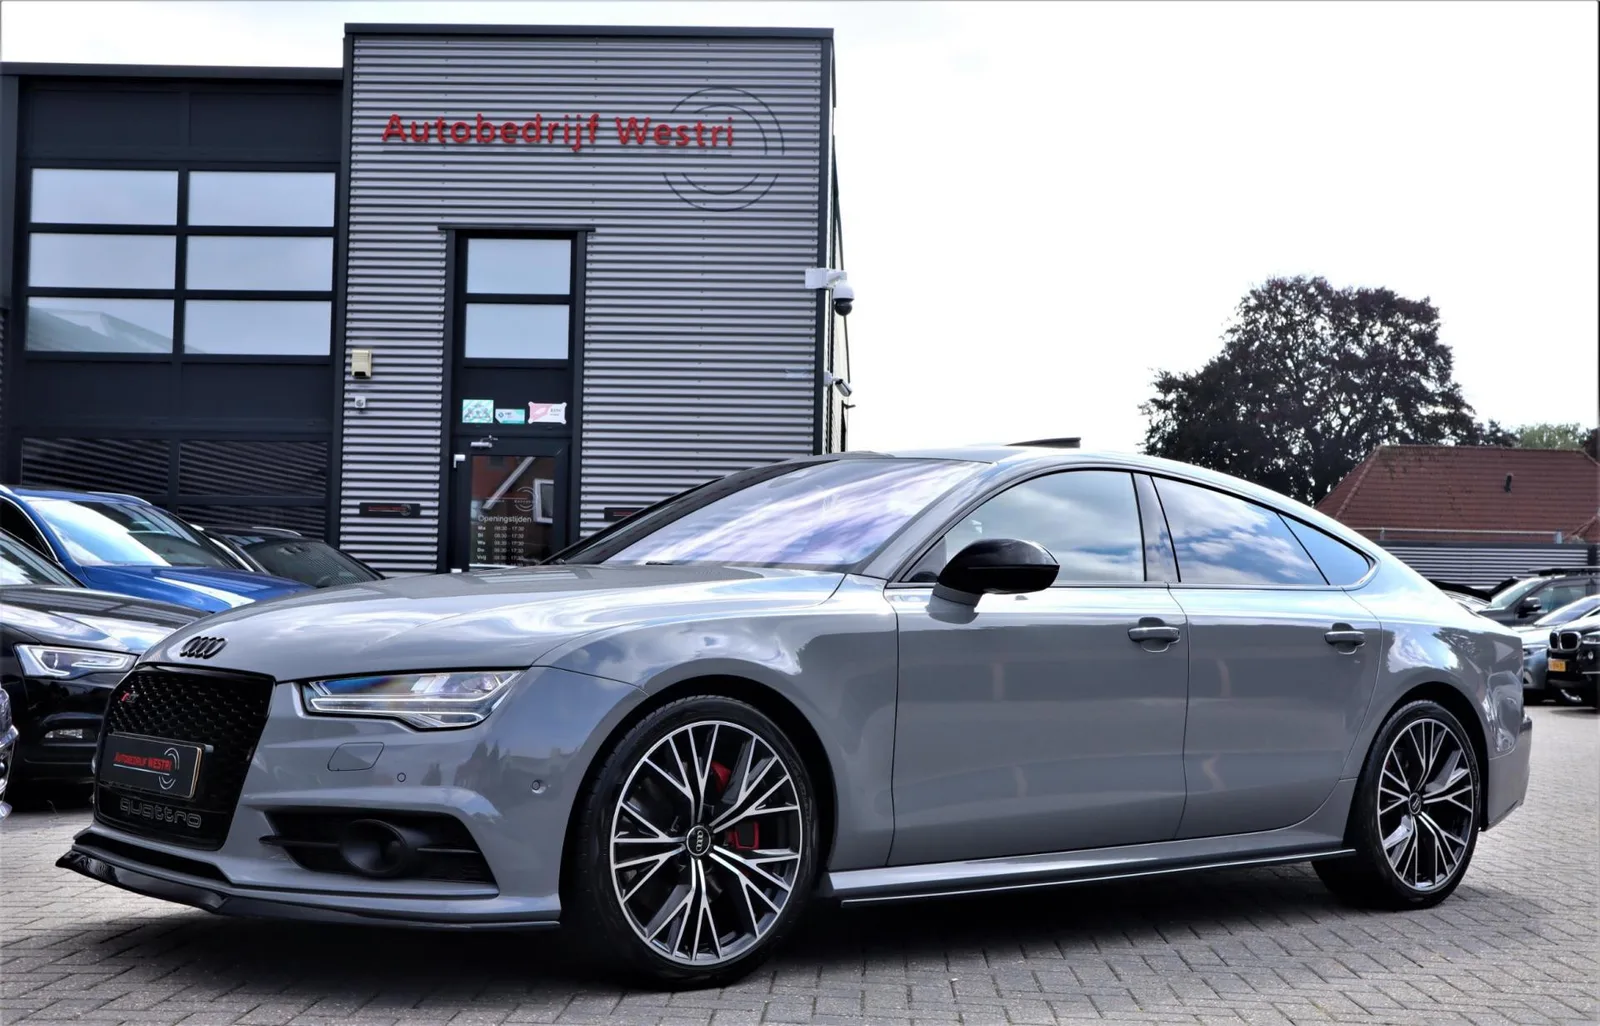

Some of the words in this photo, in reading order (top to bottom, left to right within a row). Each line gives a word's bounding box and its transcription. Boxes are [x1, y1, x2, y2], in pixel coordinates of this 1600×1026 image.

[382, 113, 600, 152] Autobedrijf
[615, 116, 734, 147] Westri
[478, 515, 532, 524] Openingstijden
[120, 798, 201, 828] quattro
